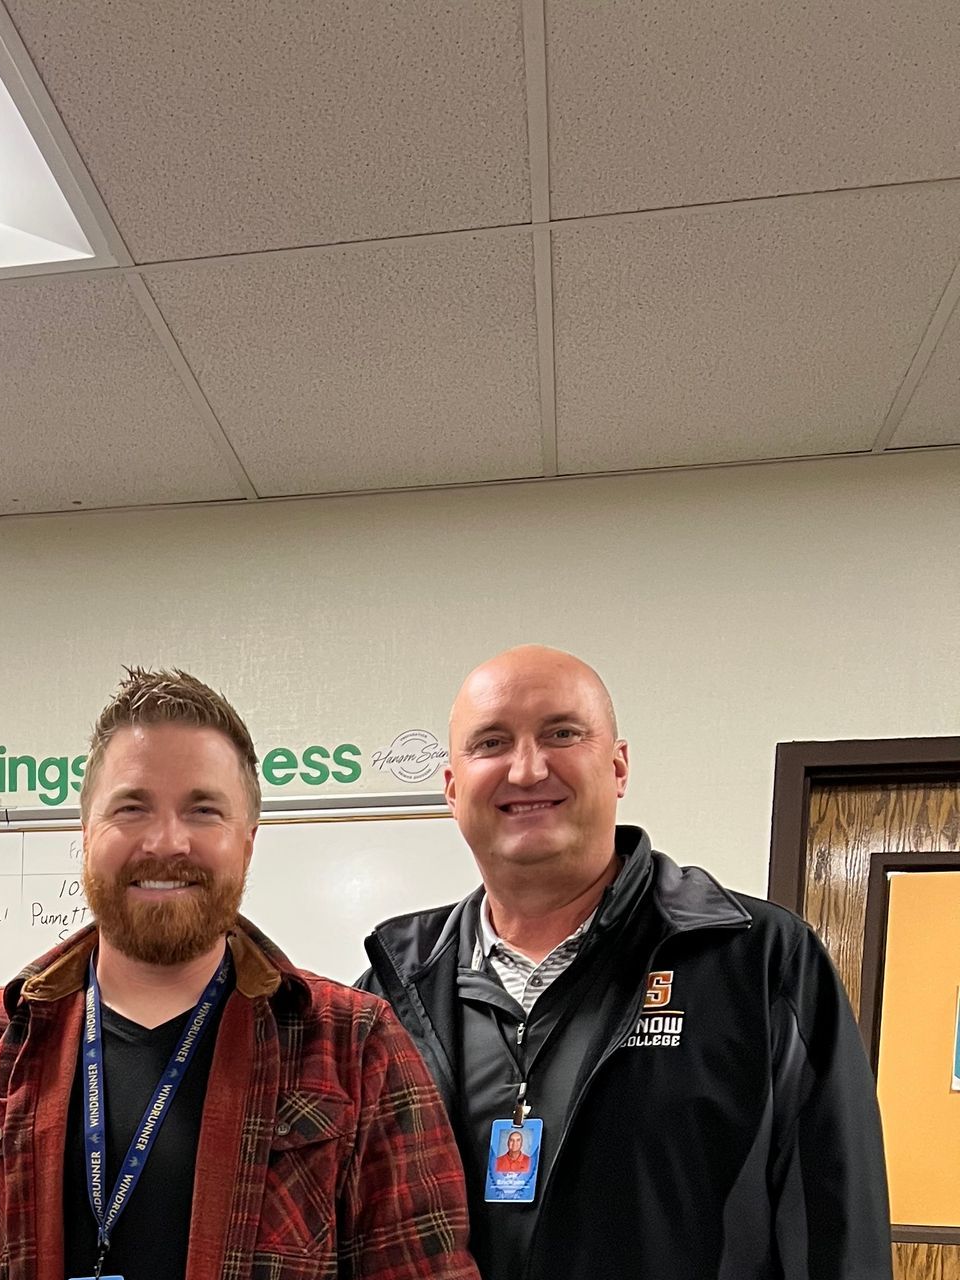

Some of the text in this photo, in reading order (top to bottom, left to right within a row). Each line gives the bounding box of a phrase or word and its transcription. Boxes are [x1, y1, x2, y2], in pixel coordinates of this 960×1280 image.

[416, 743, 449, 763] Scien
[643, 970, 674, 1008] S
[175, 1001, 212, 1063] WINDRUNNER
[636, 1016, 683, 1034] NOW
[88, 1063, 99, 1128] WINDRUNNER
[135, 1084, 173, 1151] WINDRUNNER
